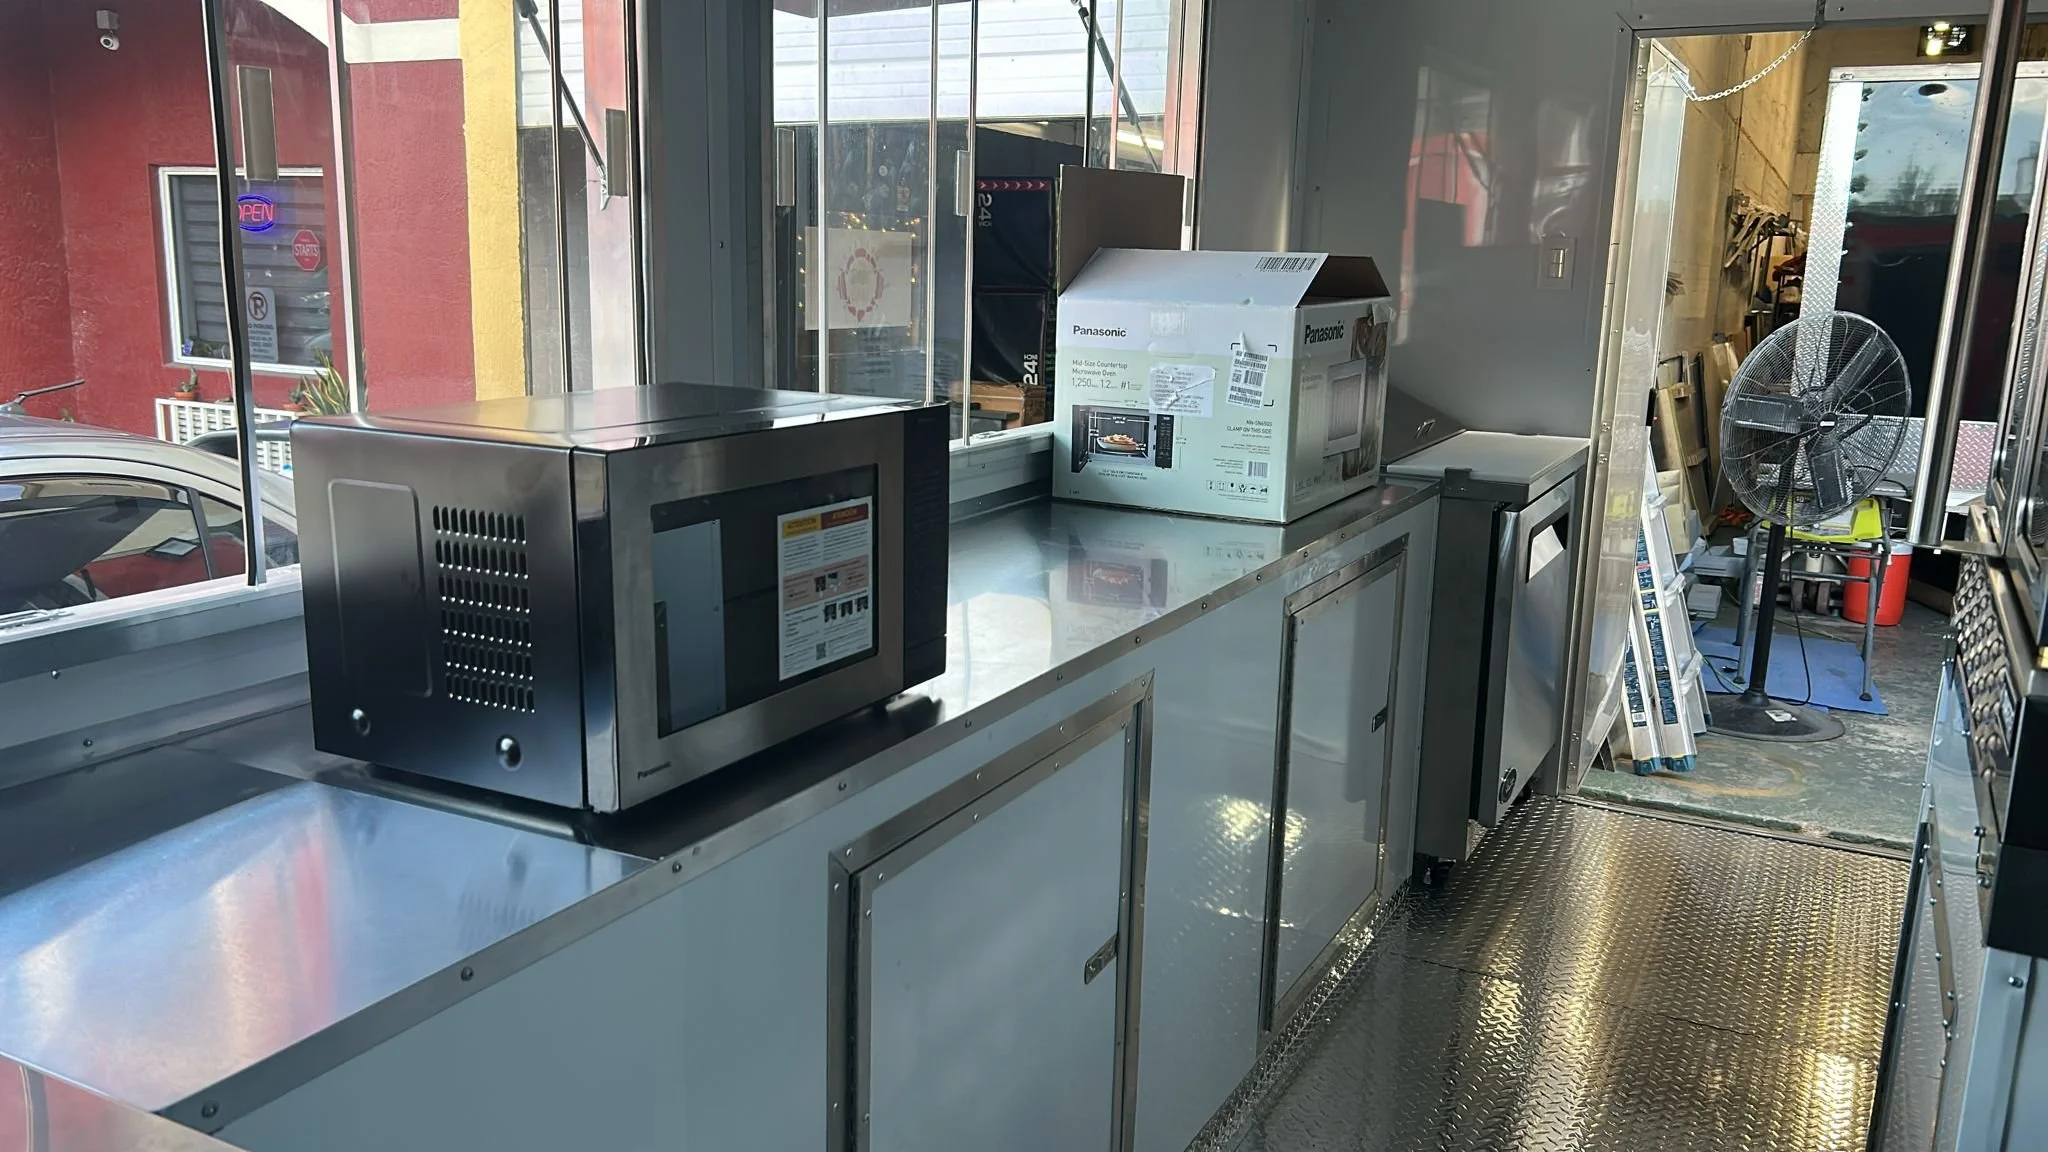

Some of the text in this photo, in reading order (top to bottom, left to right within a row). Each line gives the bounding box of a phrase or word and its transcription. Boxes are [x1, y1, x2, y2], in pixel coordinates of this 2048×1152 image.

[1073, 325, 1127, 338] Panasonic
[1304, 320, 1345, 345] Panasonic
[1072, 359, 1128, 369] Mid-Size Countertop
[1072, 368, 1117, 377] Microwave Oven
[1072, 377, 1092, 388] 1,250
